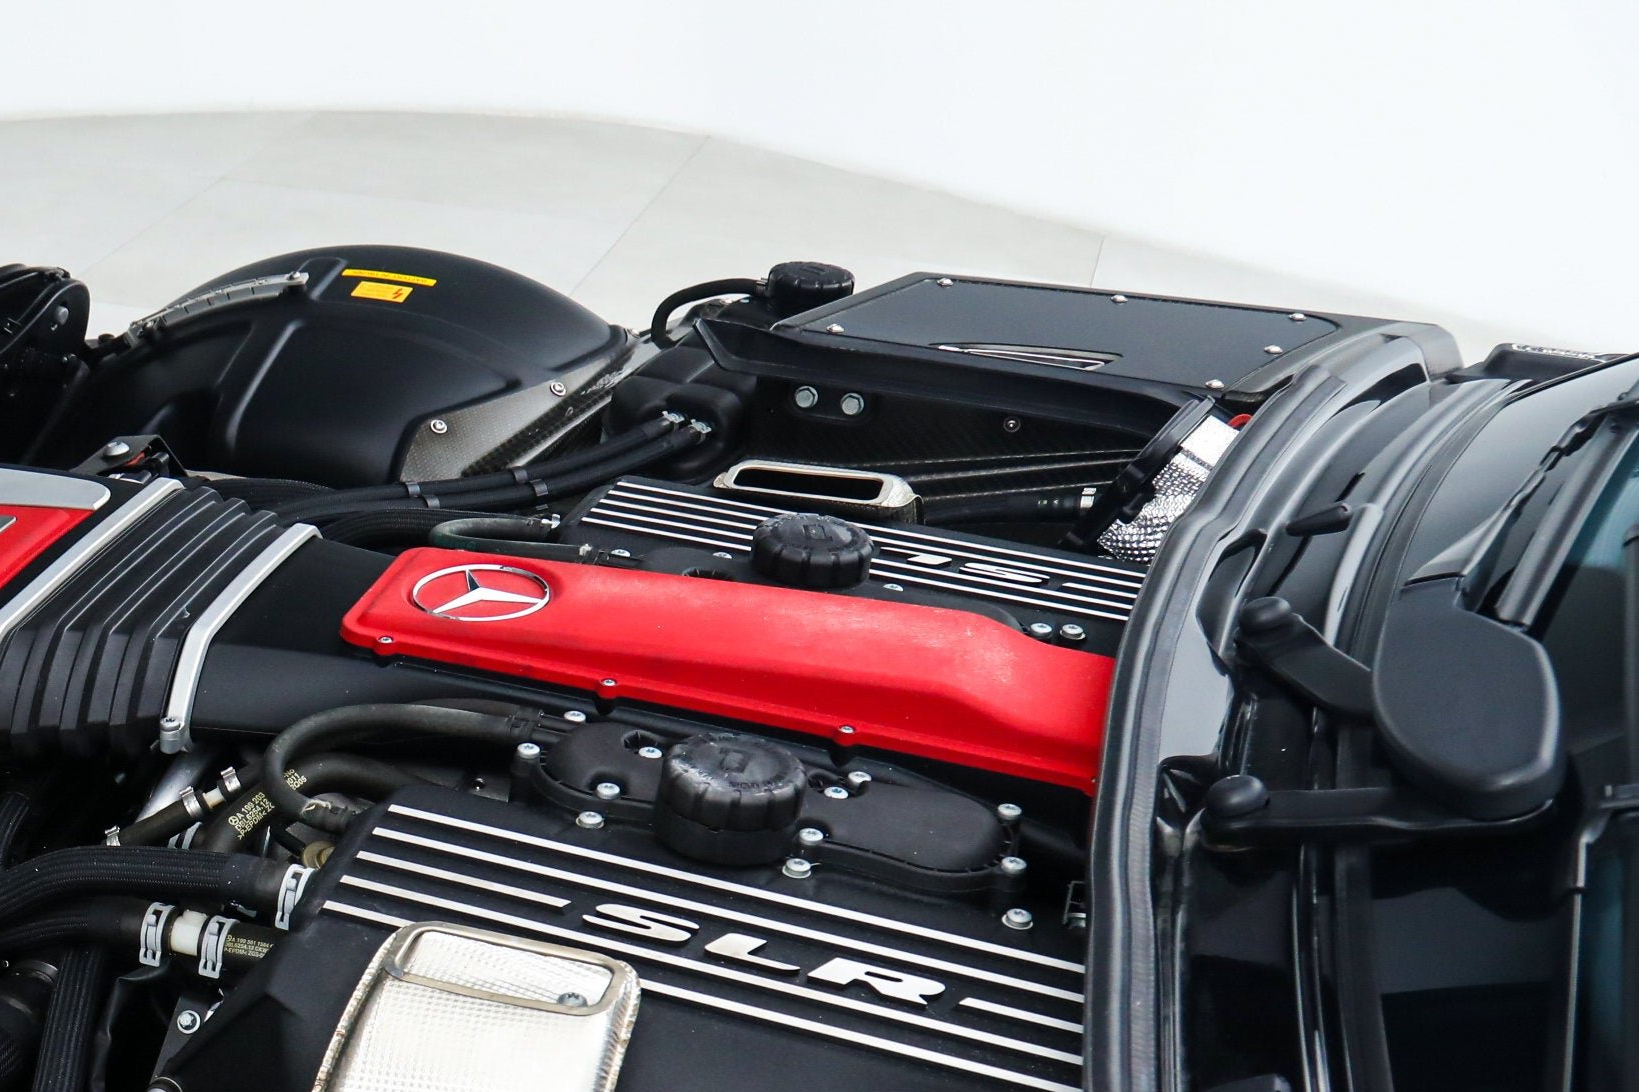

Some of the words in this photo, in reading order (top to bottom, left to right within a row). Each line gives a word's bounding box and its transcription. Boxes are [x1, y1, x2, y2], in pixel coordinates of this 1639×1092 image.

[235, 799, 270, 832] DBL6254.12
[236, 812, 244, 820] A
[242, 801, 254, 814] 199
[252, 792, 266, 805] 203
[582, 903, 947, 1006] SLR
